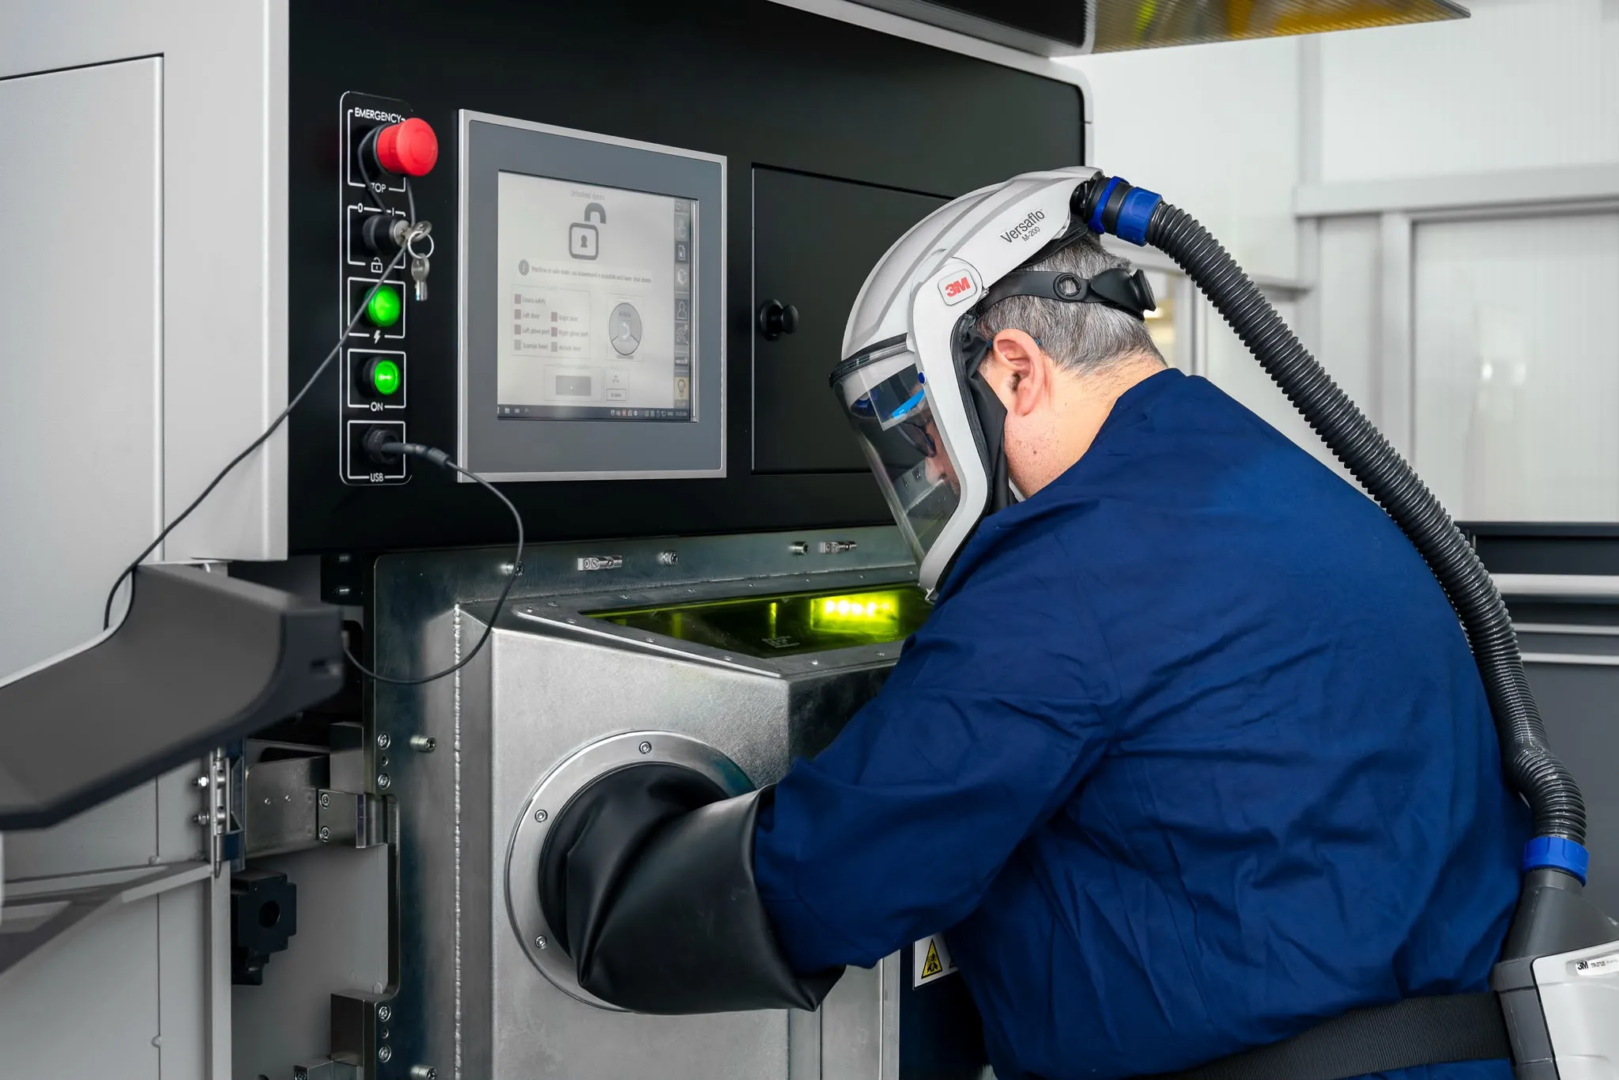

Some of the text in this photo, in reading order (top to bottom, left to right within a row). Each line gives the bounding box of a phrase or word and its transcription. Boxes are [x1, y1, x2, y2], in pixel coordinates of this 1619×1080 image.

[354, 106, 402, 123] EMERGENCY
[366, 180, 387, 193] TOP
[1000, 209, 1045, 243] Versaflo
[1021, 226, 1041, 242] M-200
[945, 276, 971, 298] 3M
[370, 401, 383, 411] ON
[369, 472, 384, 482] USB
[1577, 961, 1589, 970] 3M
